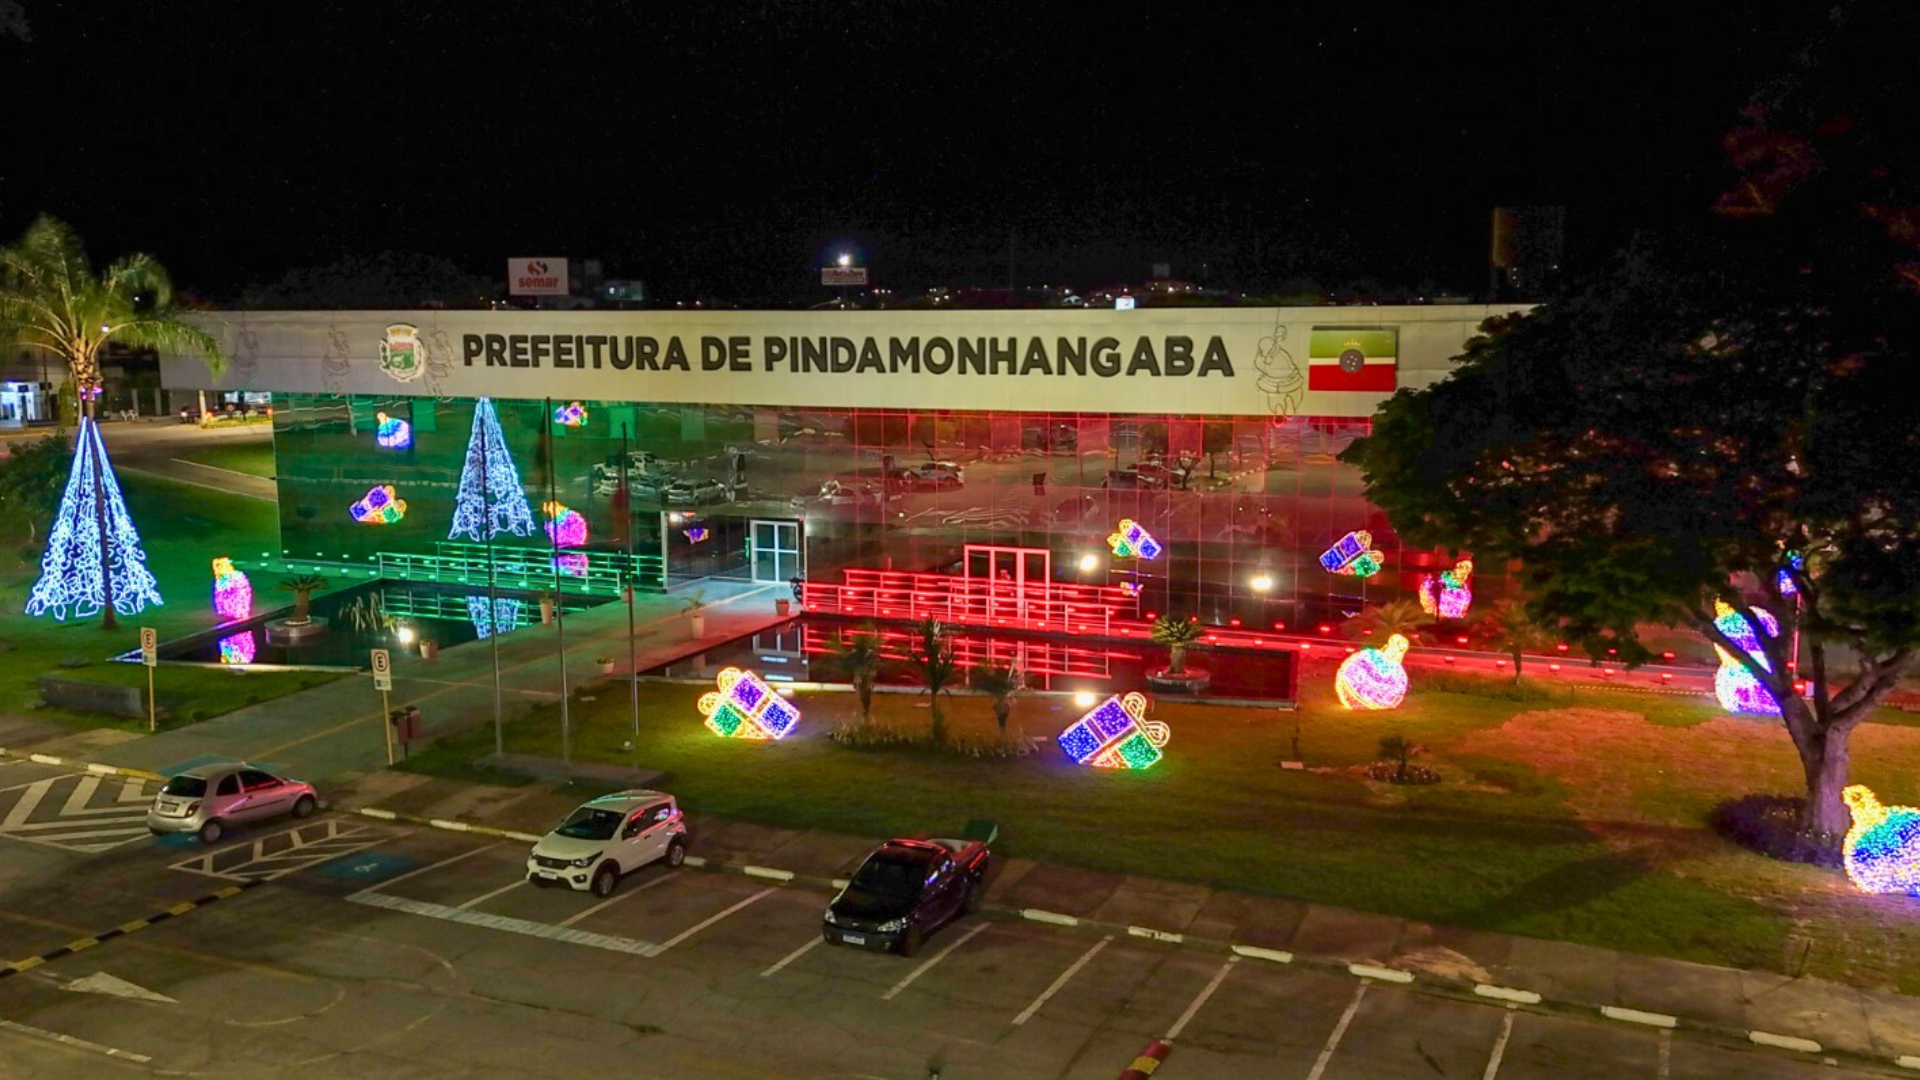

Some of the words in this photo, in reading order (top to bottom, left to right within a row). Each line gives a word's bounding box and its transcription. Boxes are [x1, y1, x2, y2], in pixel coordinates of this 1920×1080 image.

[518, 276, 559, 288] semar
[463, 333, 690, 371] PREFEITURA
[701, 336, 752, 371] DE
[764, 336, 1234, 378] PINDAMONHANGABA
[377, 656, 384, 668] E
